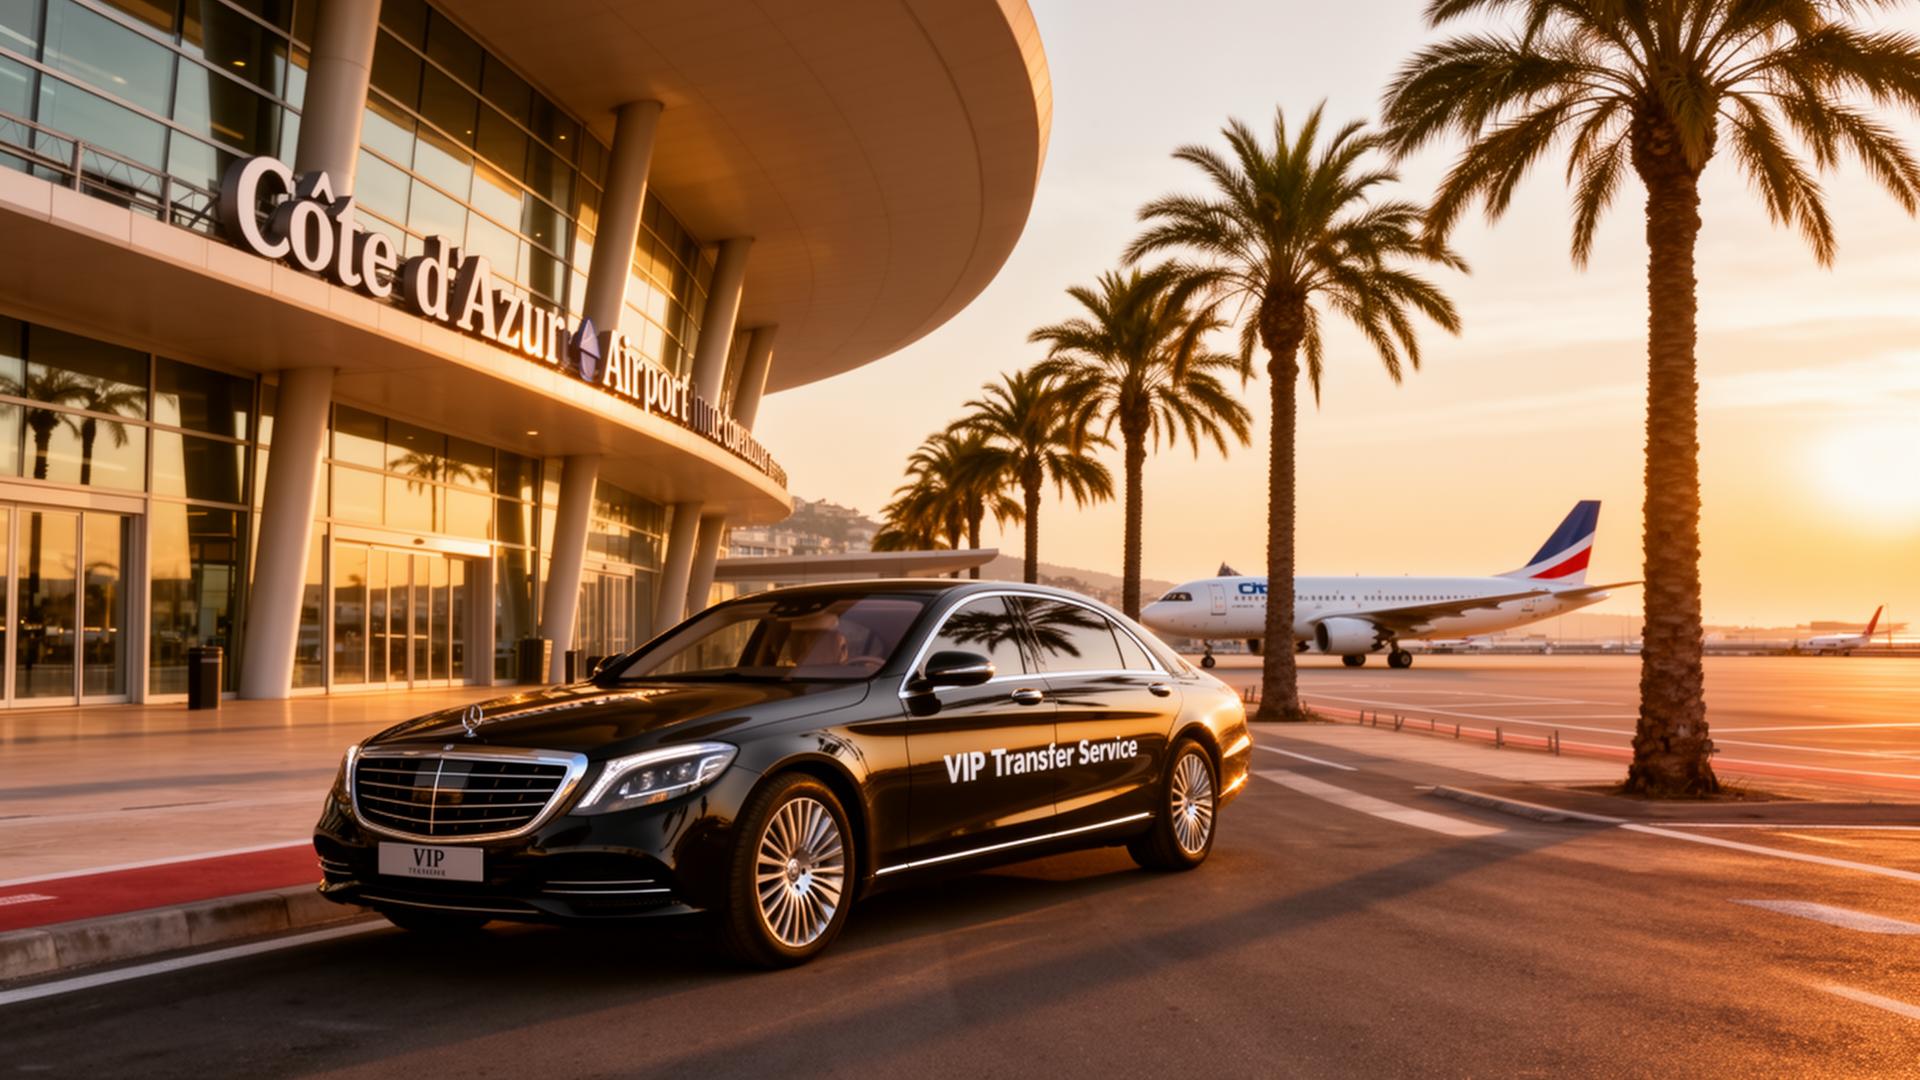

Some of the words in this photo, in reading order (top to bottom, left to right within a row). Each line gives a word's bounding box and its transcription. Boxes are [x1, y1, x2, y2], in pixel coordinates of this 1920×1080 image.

[237, 156, 397, 297] Côte
[416, 235, 565, 364] d'Azur
[603, 330, 691, 416] Airport
[944, 751, 986, 784] VIP
[991, 742, 1075, 777] Transfer
[1079, 736, 1138, 765] Service
[413, 848, 445, 868] VIP
